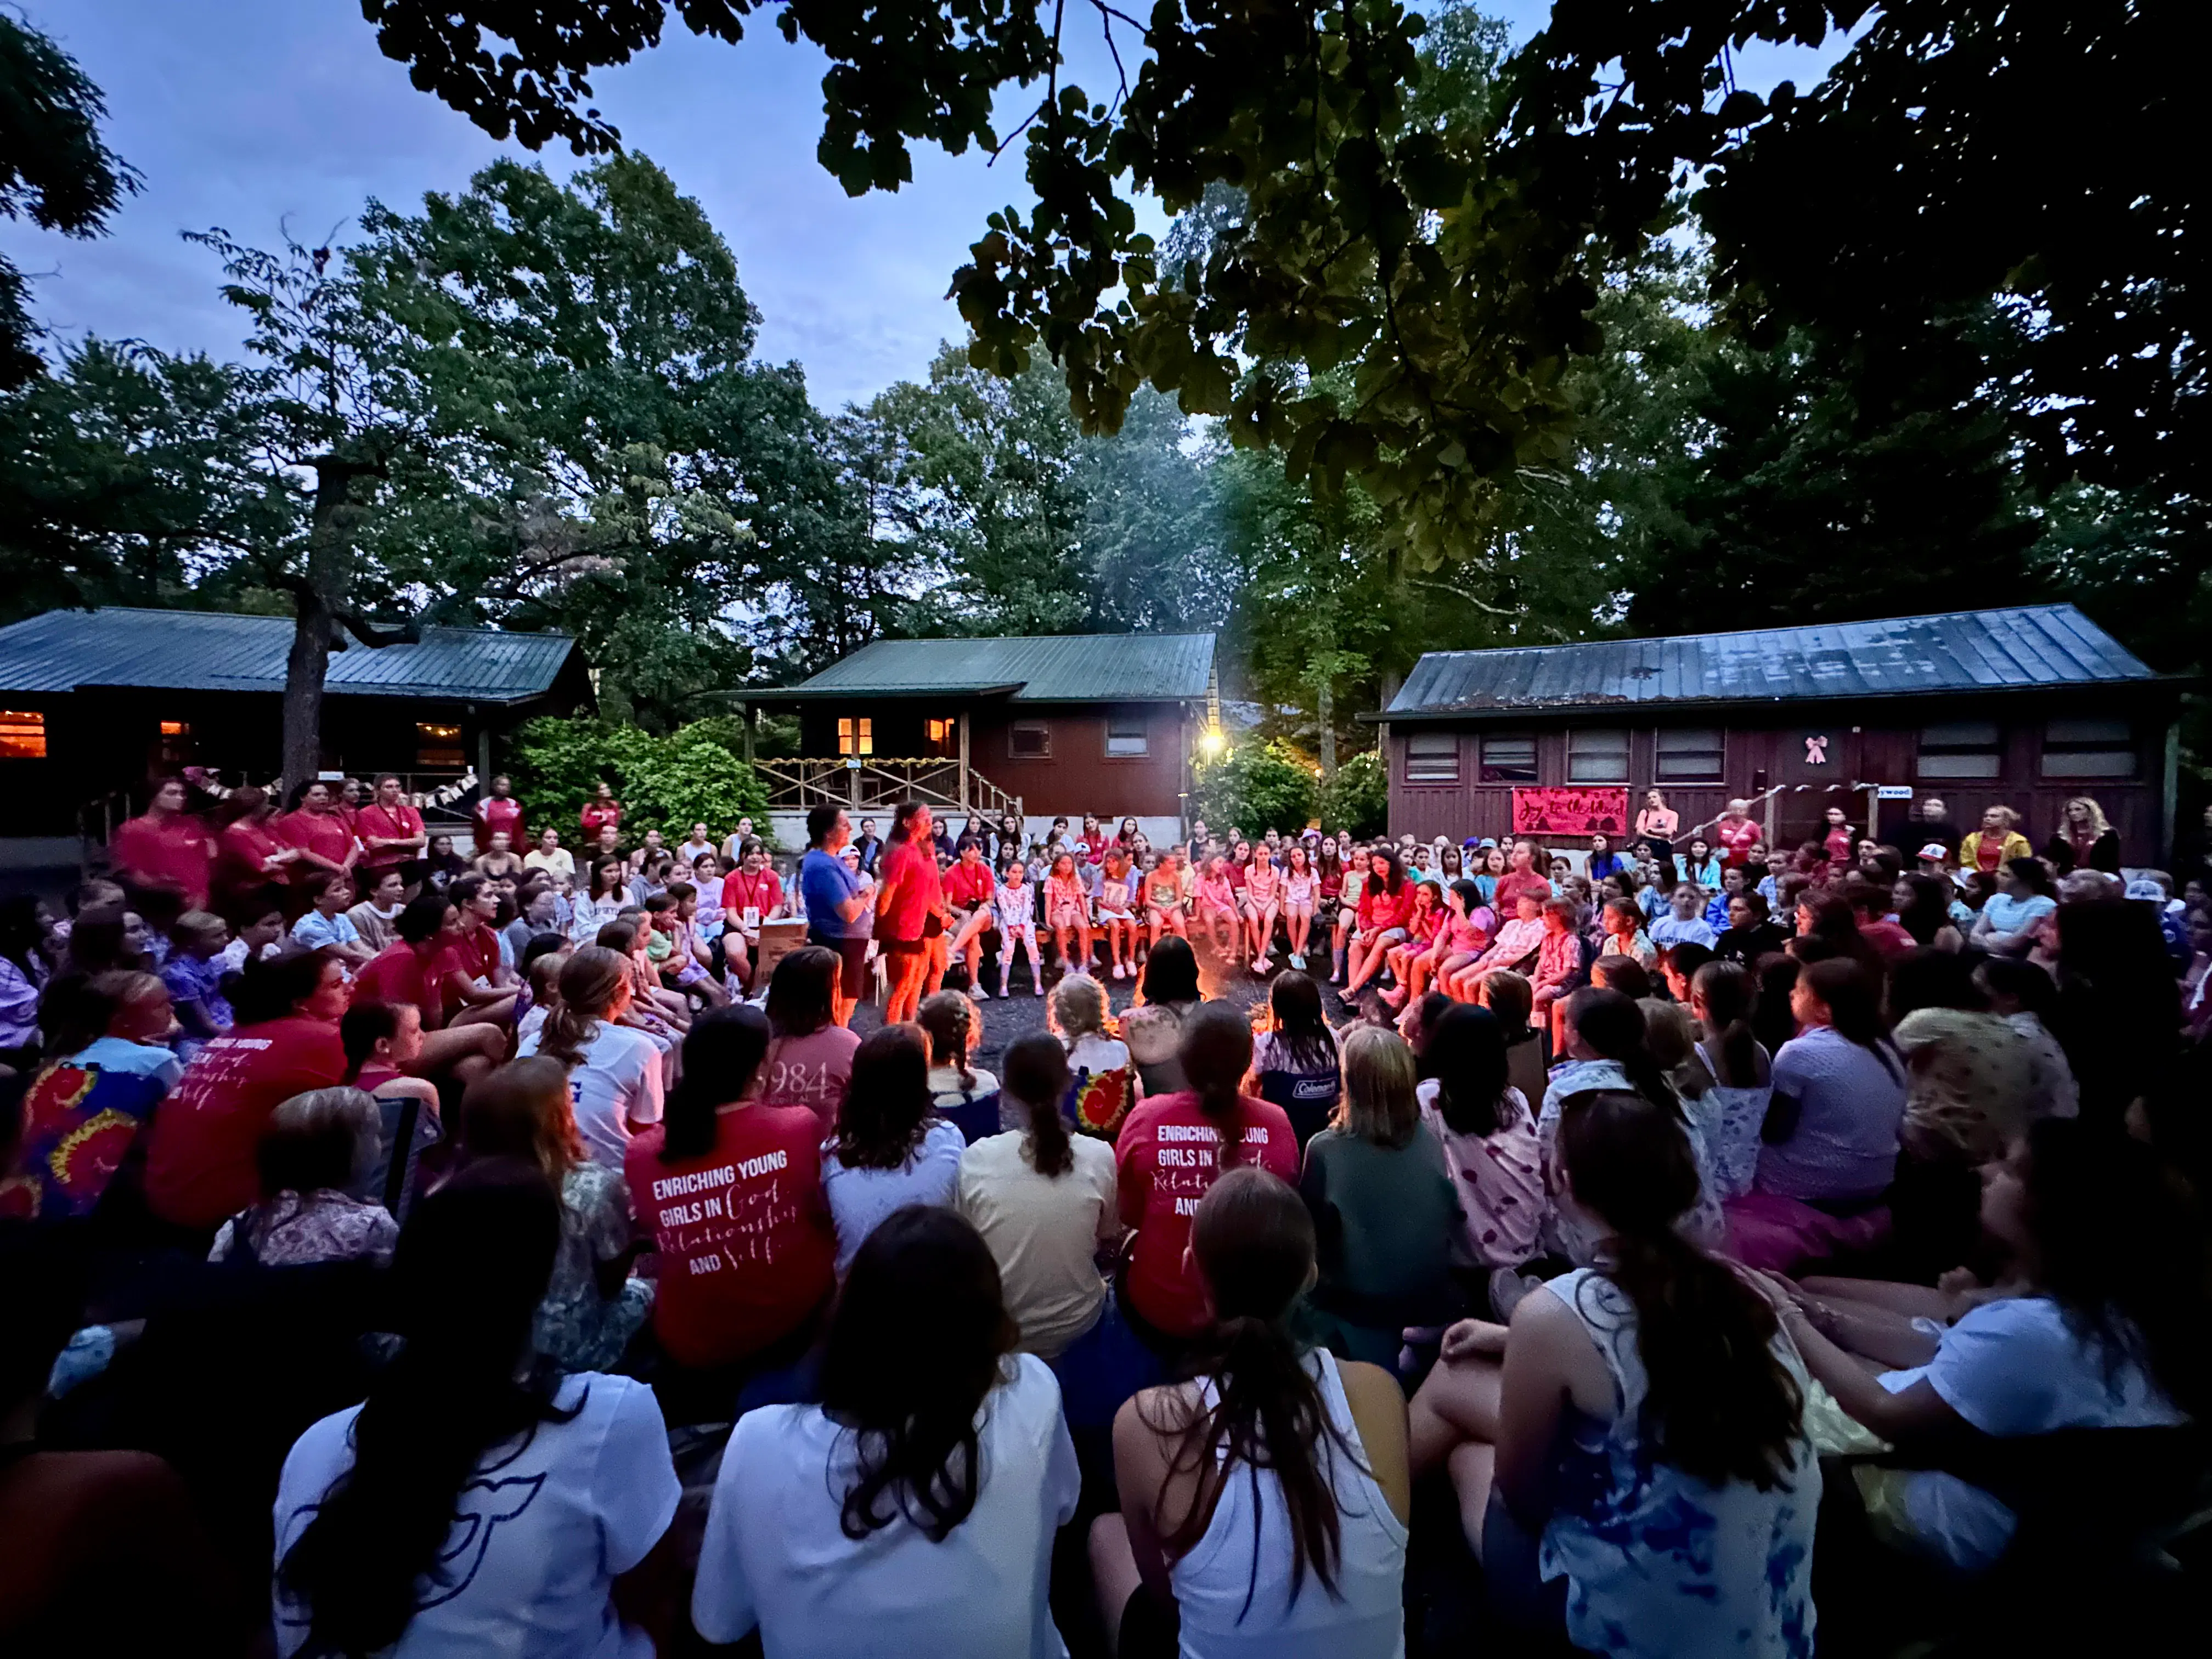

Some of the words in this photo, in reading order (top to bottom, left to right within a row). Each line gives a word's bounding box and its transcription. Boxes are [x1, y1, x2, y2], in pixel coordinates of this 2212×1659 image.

[770, 1060, 830, 1099] 984
[1239, 1126, 1268, 1144] UNG
[1158, 1149, 1196, 1166] GIRLS
[1199, 1149, 1212, 1166] IN
[652, 1165, 735, 1200] ENRICHING
[737, 1149, 788, 1180] YOUNG
[1150, 1169, 1209, 1192] Relati
[659, 1202, 703, 1228] GIRLS
[704, 1197, 722, 1218] IN
[689, 1254, 721, 1275] AND
